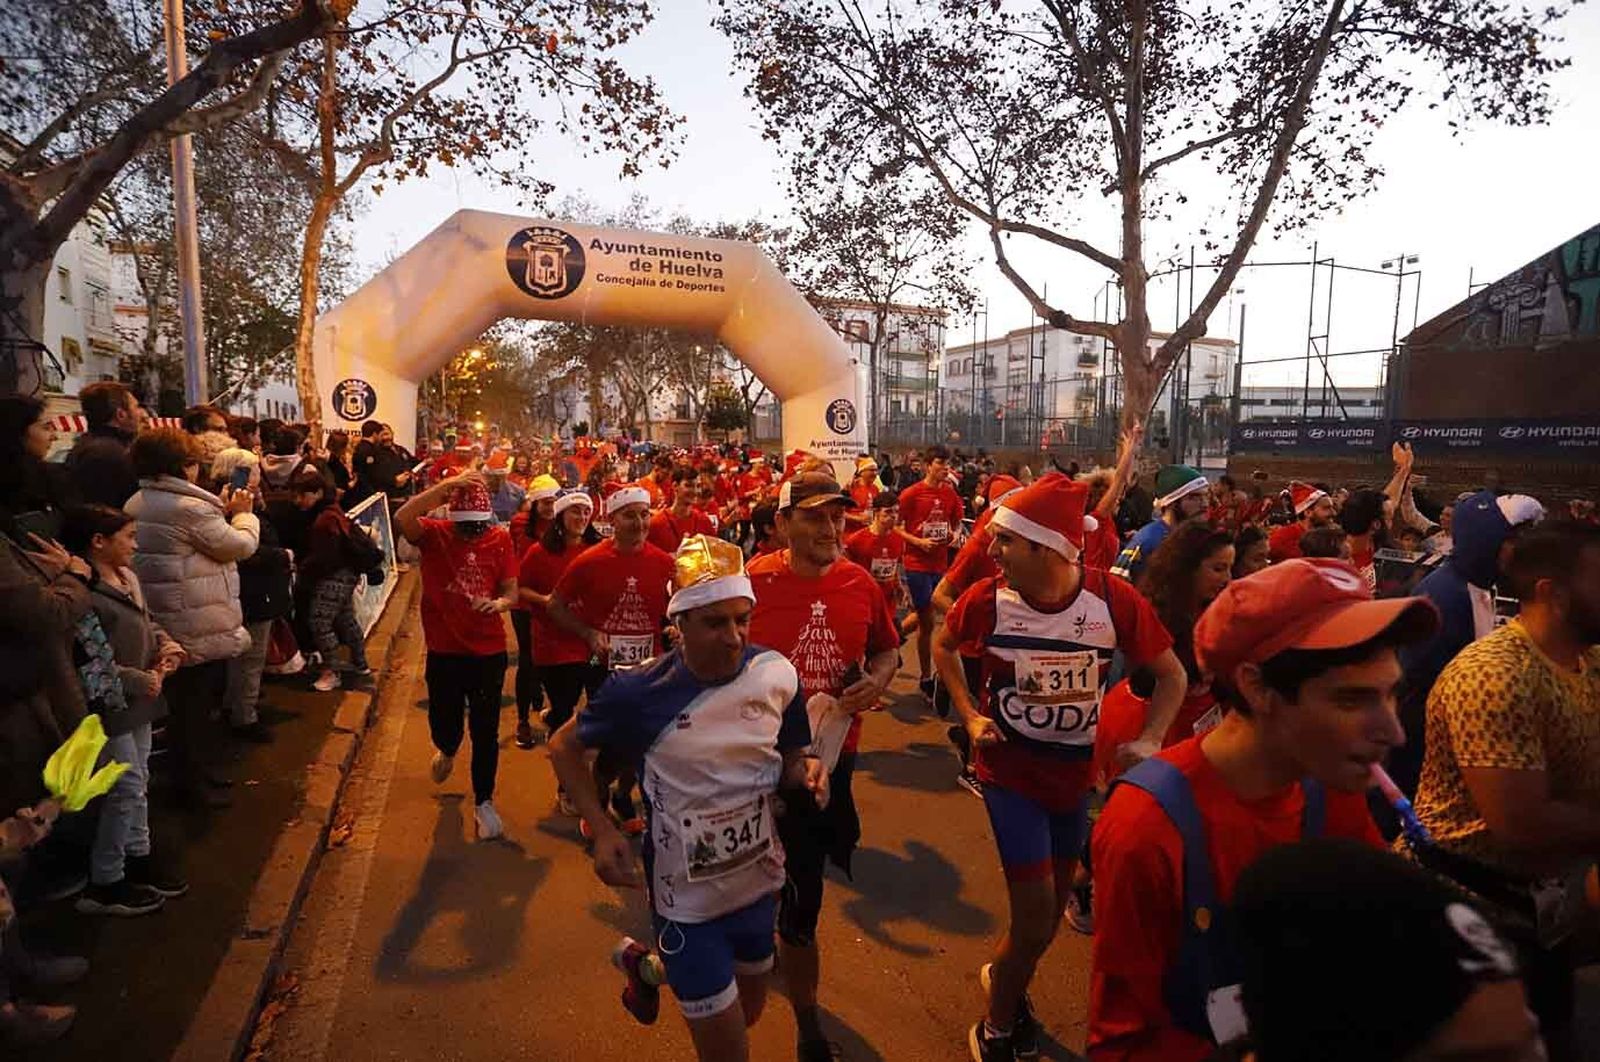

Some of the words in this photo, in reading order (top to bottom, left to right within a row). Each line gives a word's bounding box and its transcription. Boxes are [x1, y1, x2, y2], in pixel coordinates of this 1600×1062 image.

[590, 238, 723, 262] Ayuntamiento
[629, 258, 653, 272] de
[660, 260, 723, 279] Huelva
[660, 279, 673, 288] de
[676, 280, 725, 292] Deportes
[1258, 429, 1298, 437] HYUNDAI
[1327, 429, 1374, 437] HYUNDAI
[1424, 428, 1482, 437] HYUNDAI
[1528, 427, 1600, 437] HYUNDAI
[629, 645, 650, 660] 310
[1049, 668, 1088, 690] 311
[722, 812, 762, 854] 347
